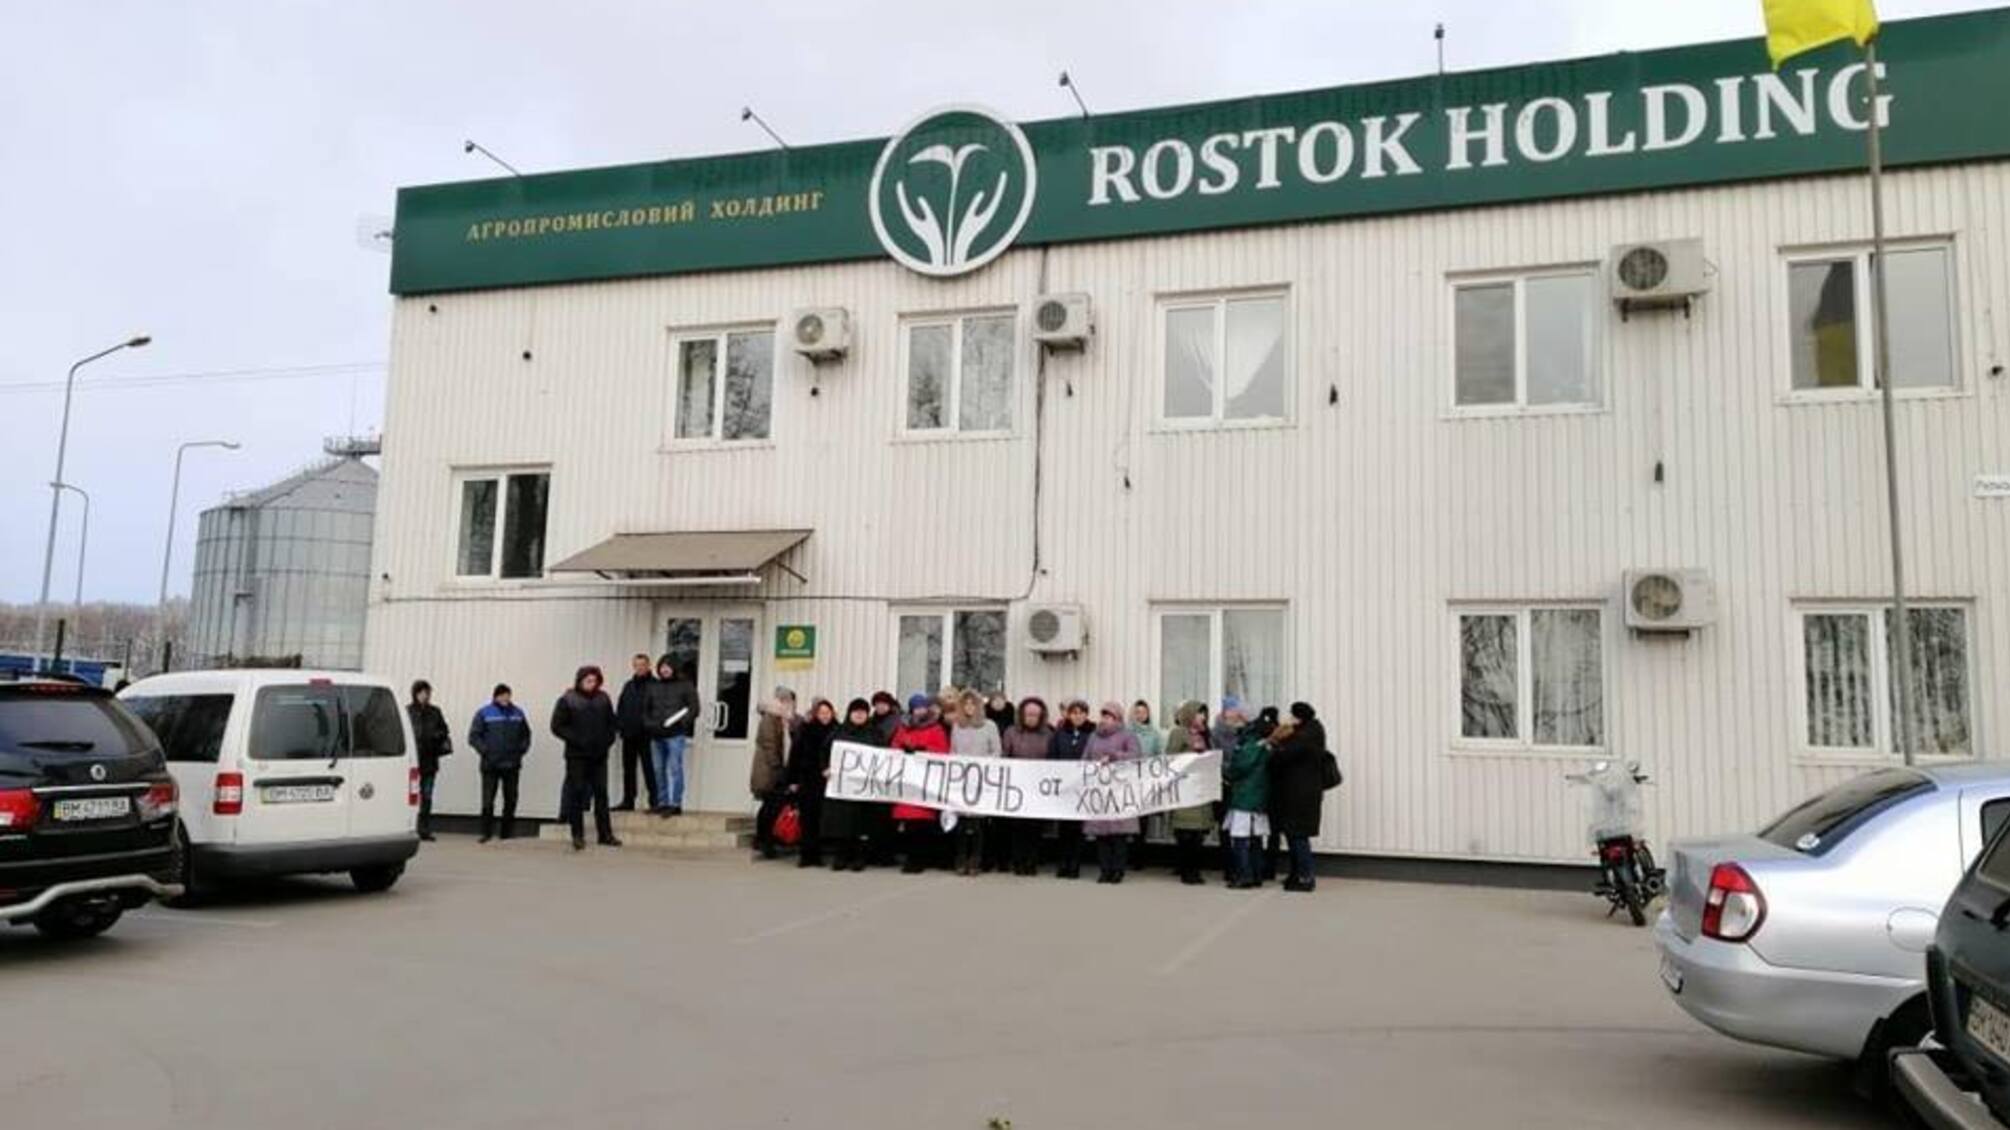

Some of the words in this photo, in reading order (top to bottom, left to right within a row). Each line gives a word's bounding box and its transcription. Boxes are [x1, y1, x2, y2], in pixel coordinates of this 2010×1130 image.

[1086, 112, 1423, 206] ROSTOK
[1444, 61, 1895, 171] HOLDING
[466, 201, 696, 242] АГРОПРОМИСЛОВИЙ
[710, 191, 824, 220] ХОЛДИНГ
[837, 750, 904, 796] РУКИ
[922, 760, 1024, 812] ПРОЧЬ
[1075, 773, 1190, 815] ХОЛДИНГ
[1081, 757, 1182, 787] РОСТОК
